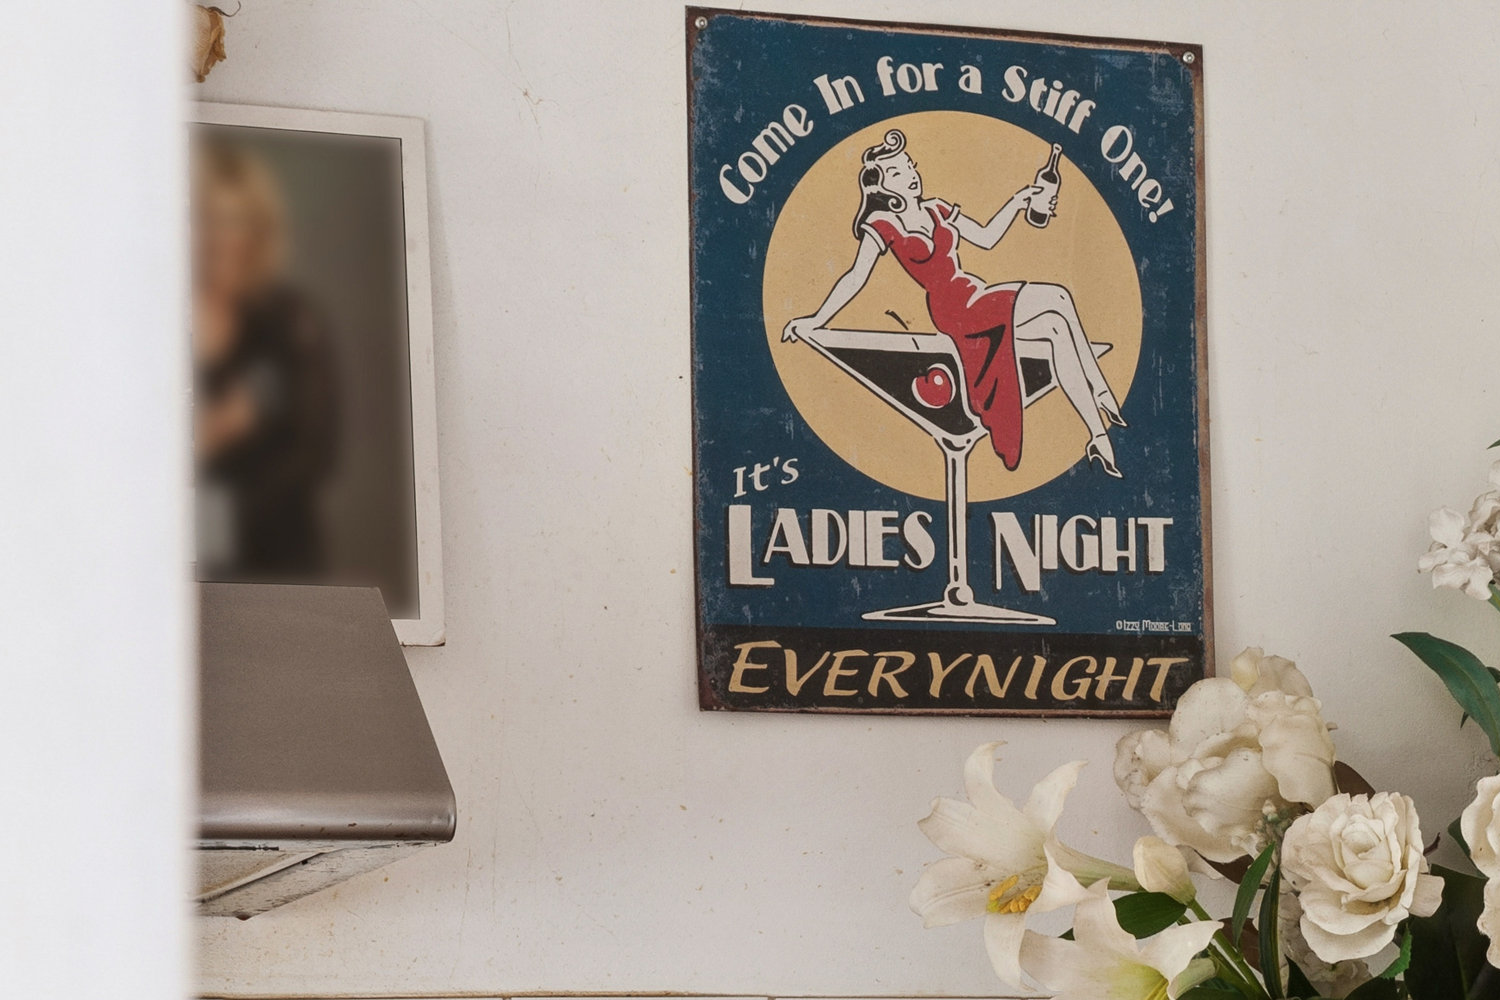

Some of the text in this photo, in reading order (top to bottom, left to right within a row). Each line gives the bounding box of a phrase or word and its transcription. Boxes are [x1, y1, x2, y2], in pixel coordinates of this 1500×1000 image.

[719, 55, 1174, 224] Come In for a Stiff One!
[732, 457, 800, 498] It's
[727, 504, 1174, 592] LADIES NIGHT
[728, 639, 1190, 703] EVERYNIGHT
